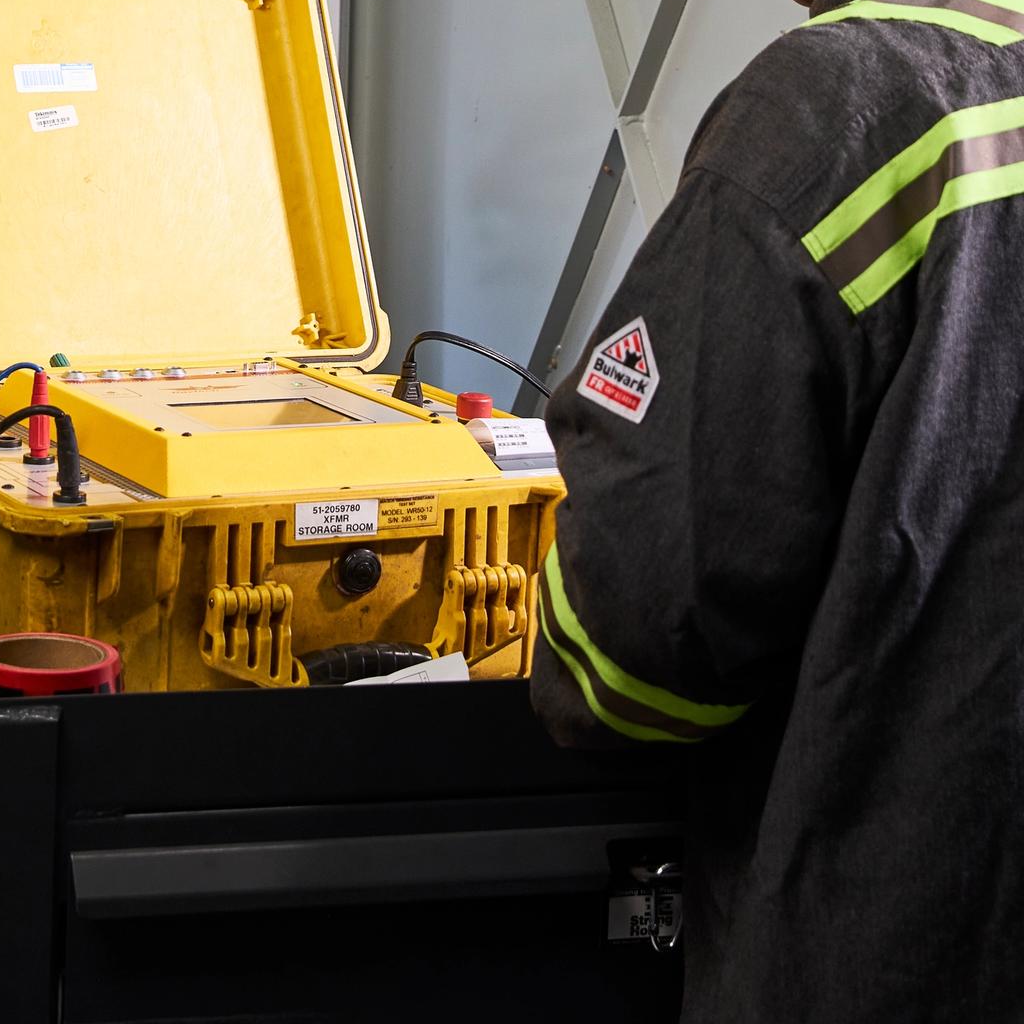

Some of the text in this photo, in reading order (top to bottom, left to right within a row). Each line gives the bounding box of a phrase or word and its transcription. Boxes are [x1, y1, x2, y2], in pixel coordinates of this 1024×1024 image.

[593, 357, 649, 394] Bulwark
[588, 375, 605, 391] FR
[313, 504, 360, 514] 51-2059780
[323, 514, 350, 524] XFMR
[298, 523, 373, 536] STORAGE ROOM
[630, 915, 673, 927] Strng
